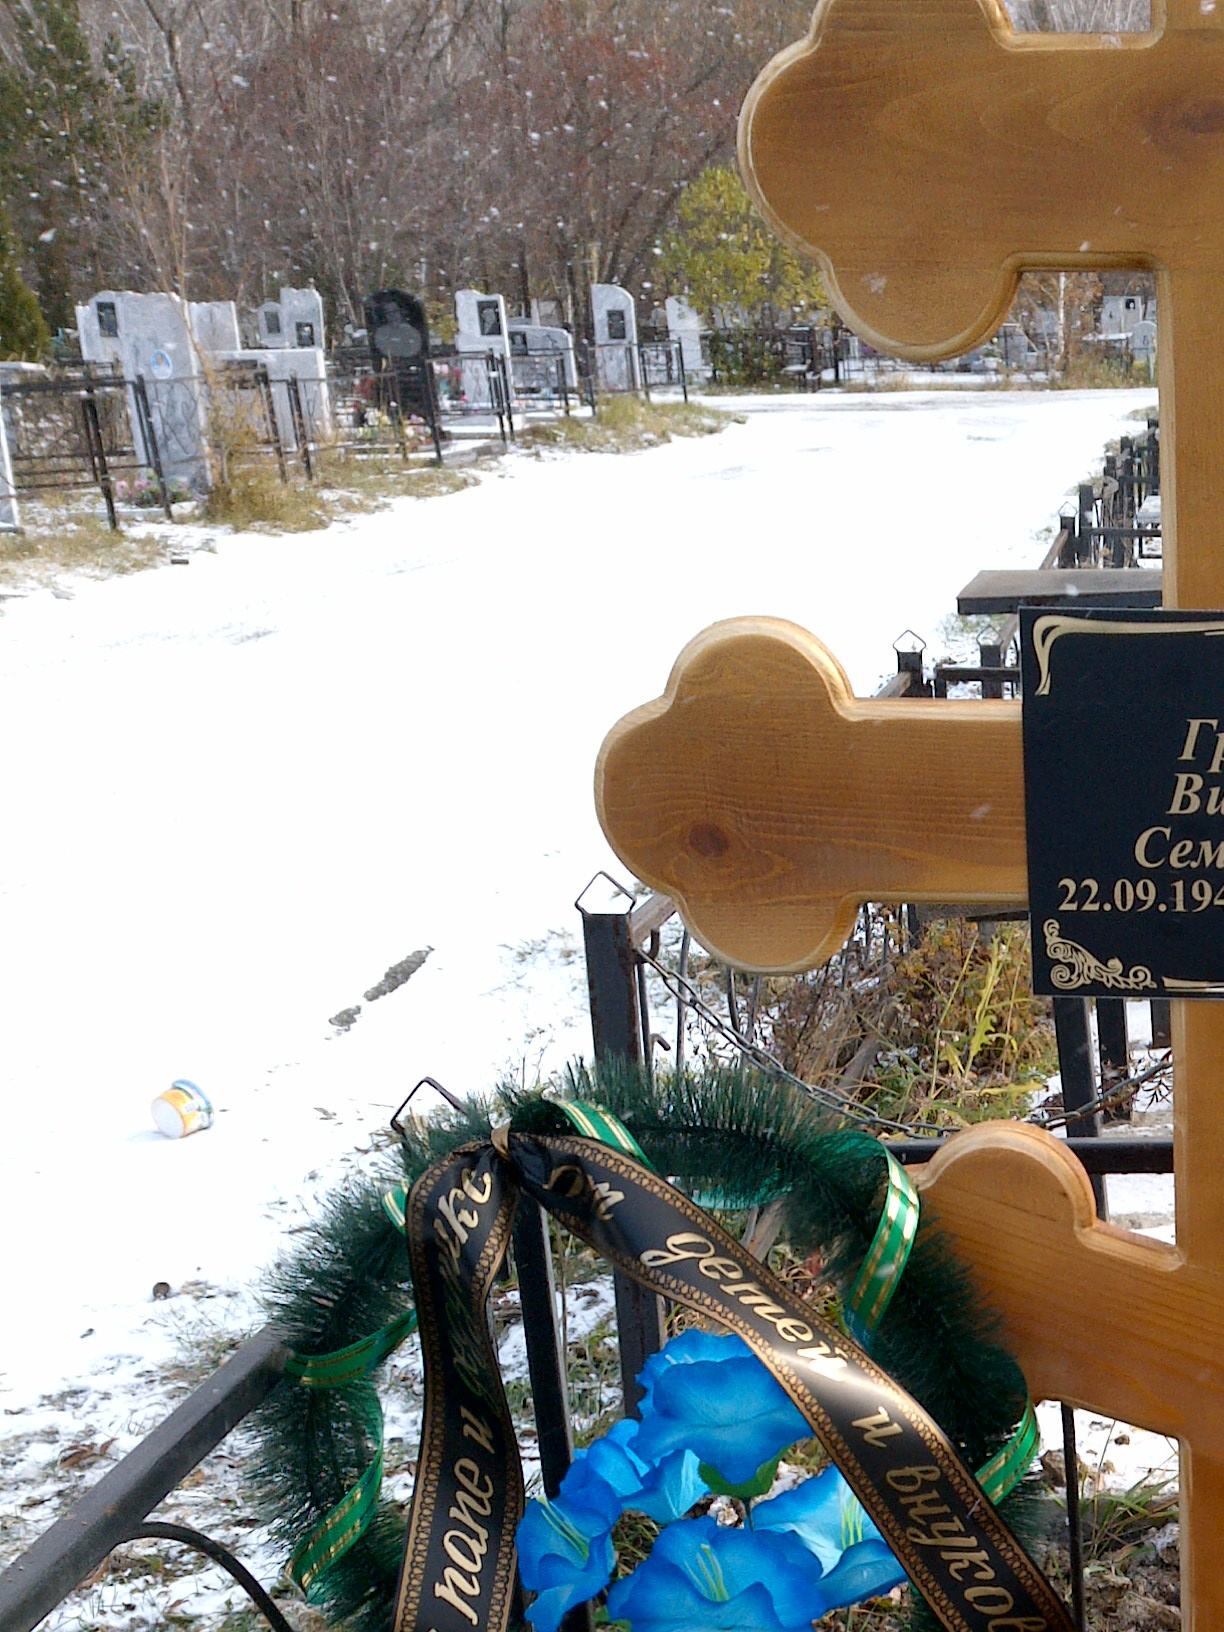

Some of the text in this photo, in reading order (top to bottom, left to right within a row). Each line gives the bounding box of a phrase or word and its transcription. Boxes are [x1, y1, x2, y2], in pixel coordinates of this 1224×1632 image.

[639, 1232, 848, 1383] детей
[851, 1405, 903, 1449] и
[460, 1405, 497, 1456] и
[435, 1457, 495, 1627] папе
